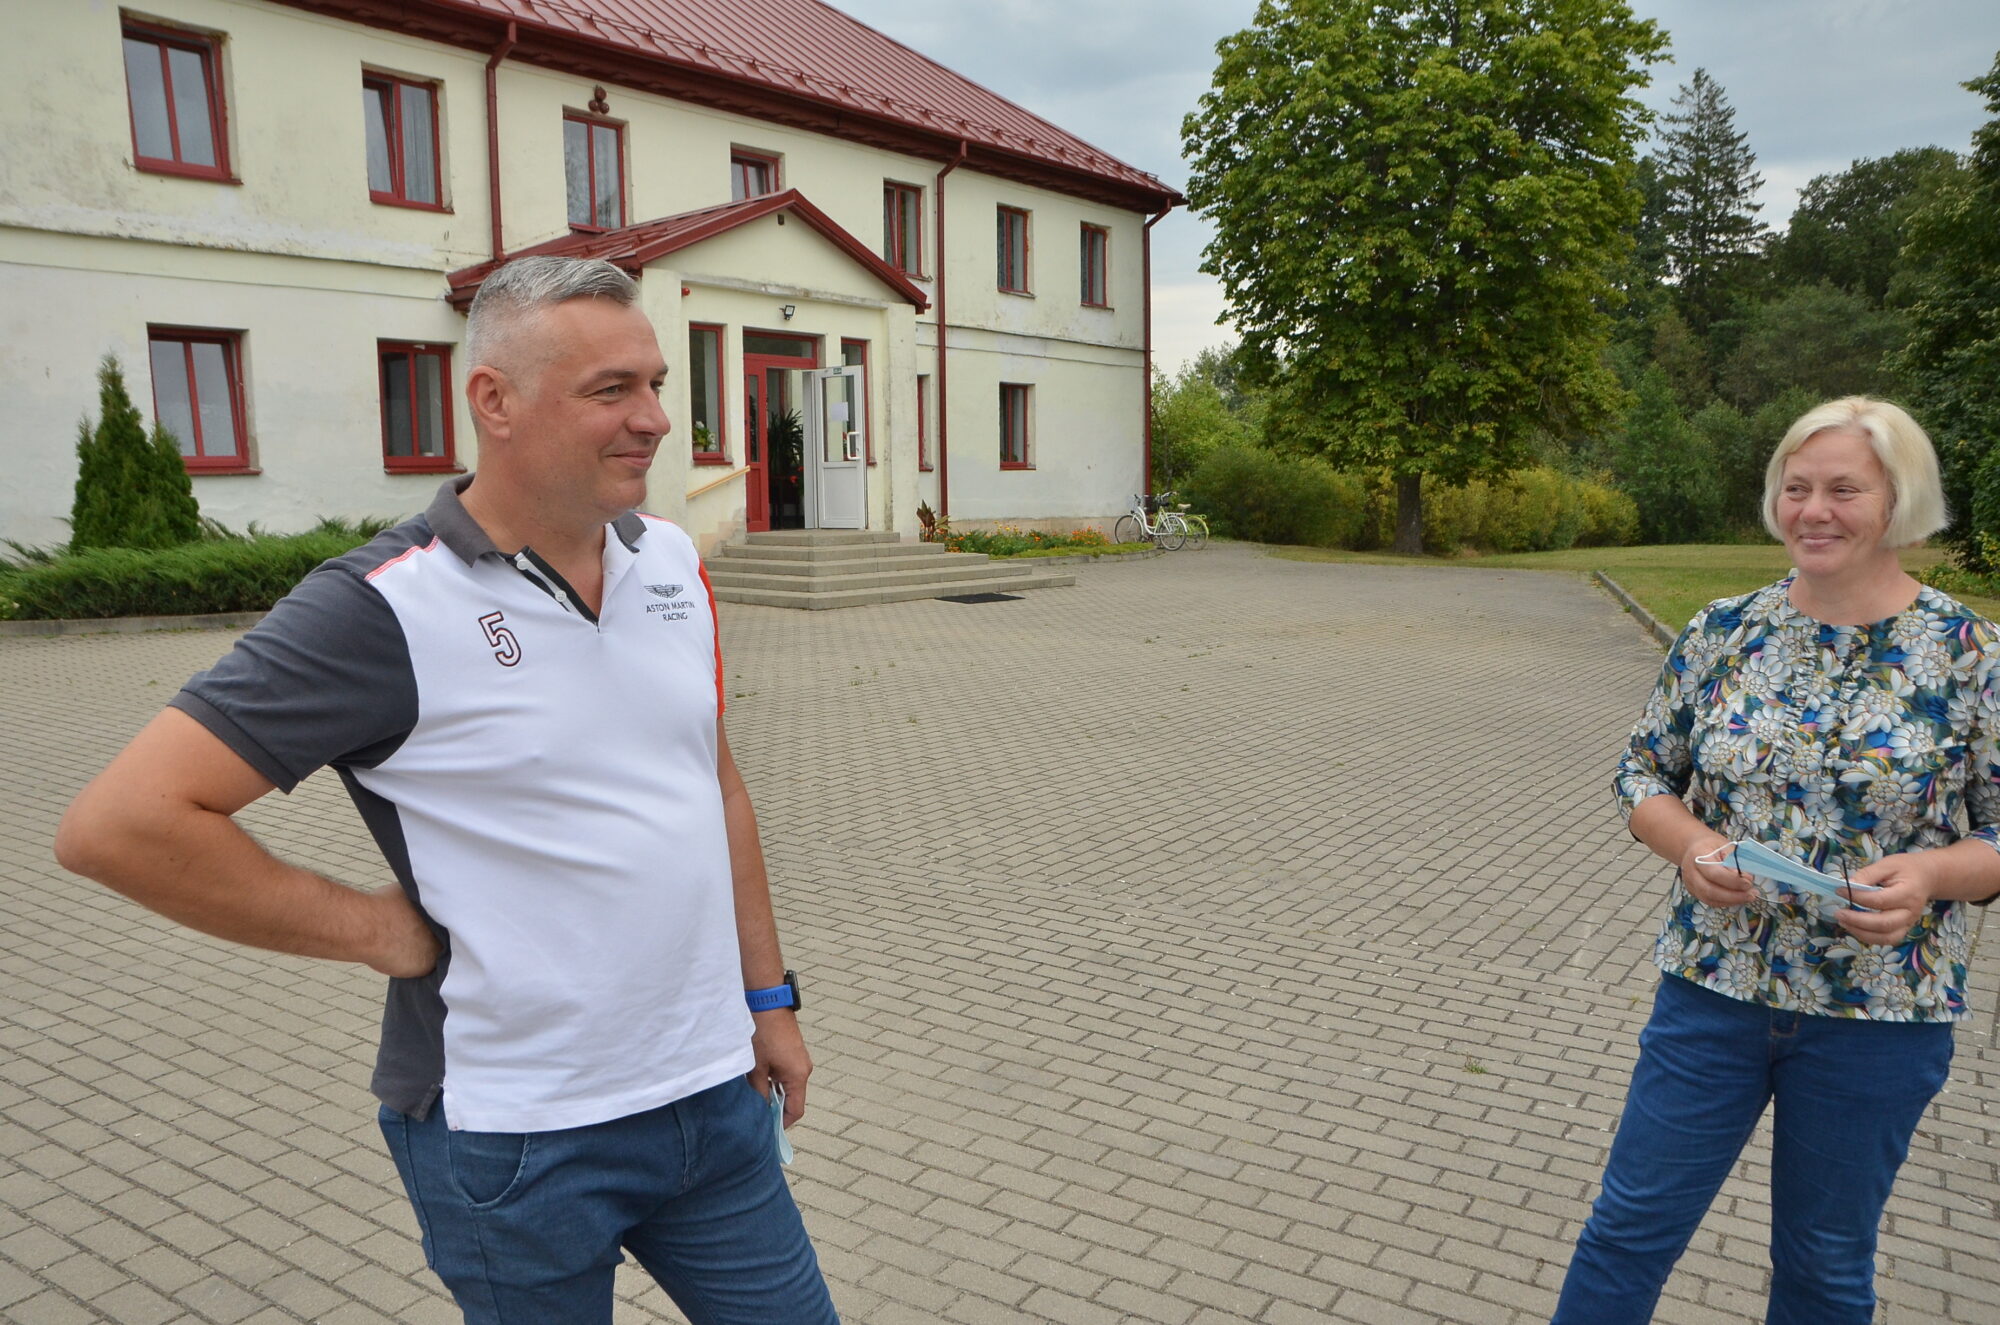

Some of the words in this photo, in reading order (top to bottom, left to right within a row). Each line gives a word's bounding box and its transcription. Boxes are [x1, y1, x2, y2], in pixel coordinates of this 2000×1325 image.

[646, 602, 670, 613] ASTON
[671, 601, 695, 610] MARTIN
[662, 612, 688, 621] RACING
[478, 611, 522, 667] 5
